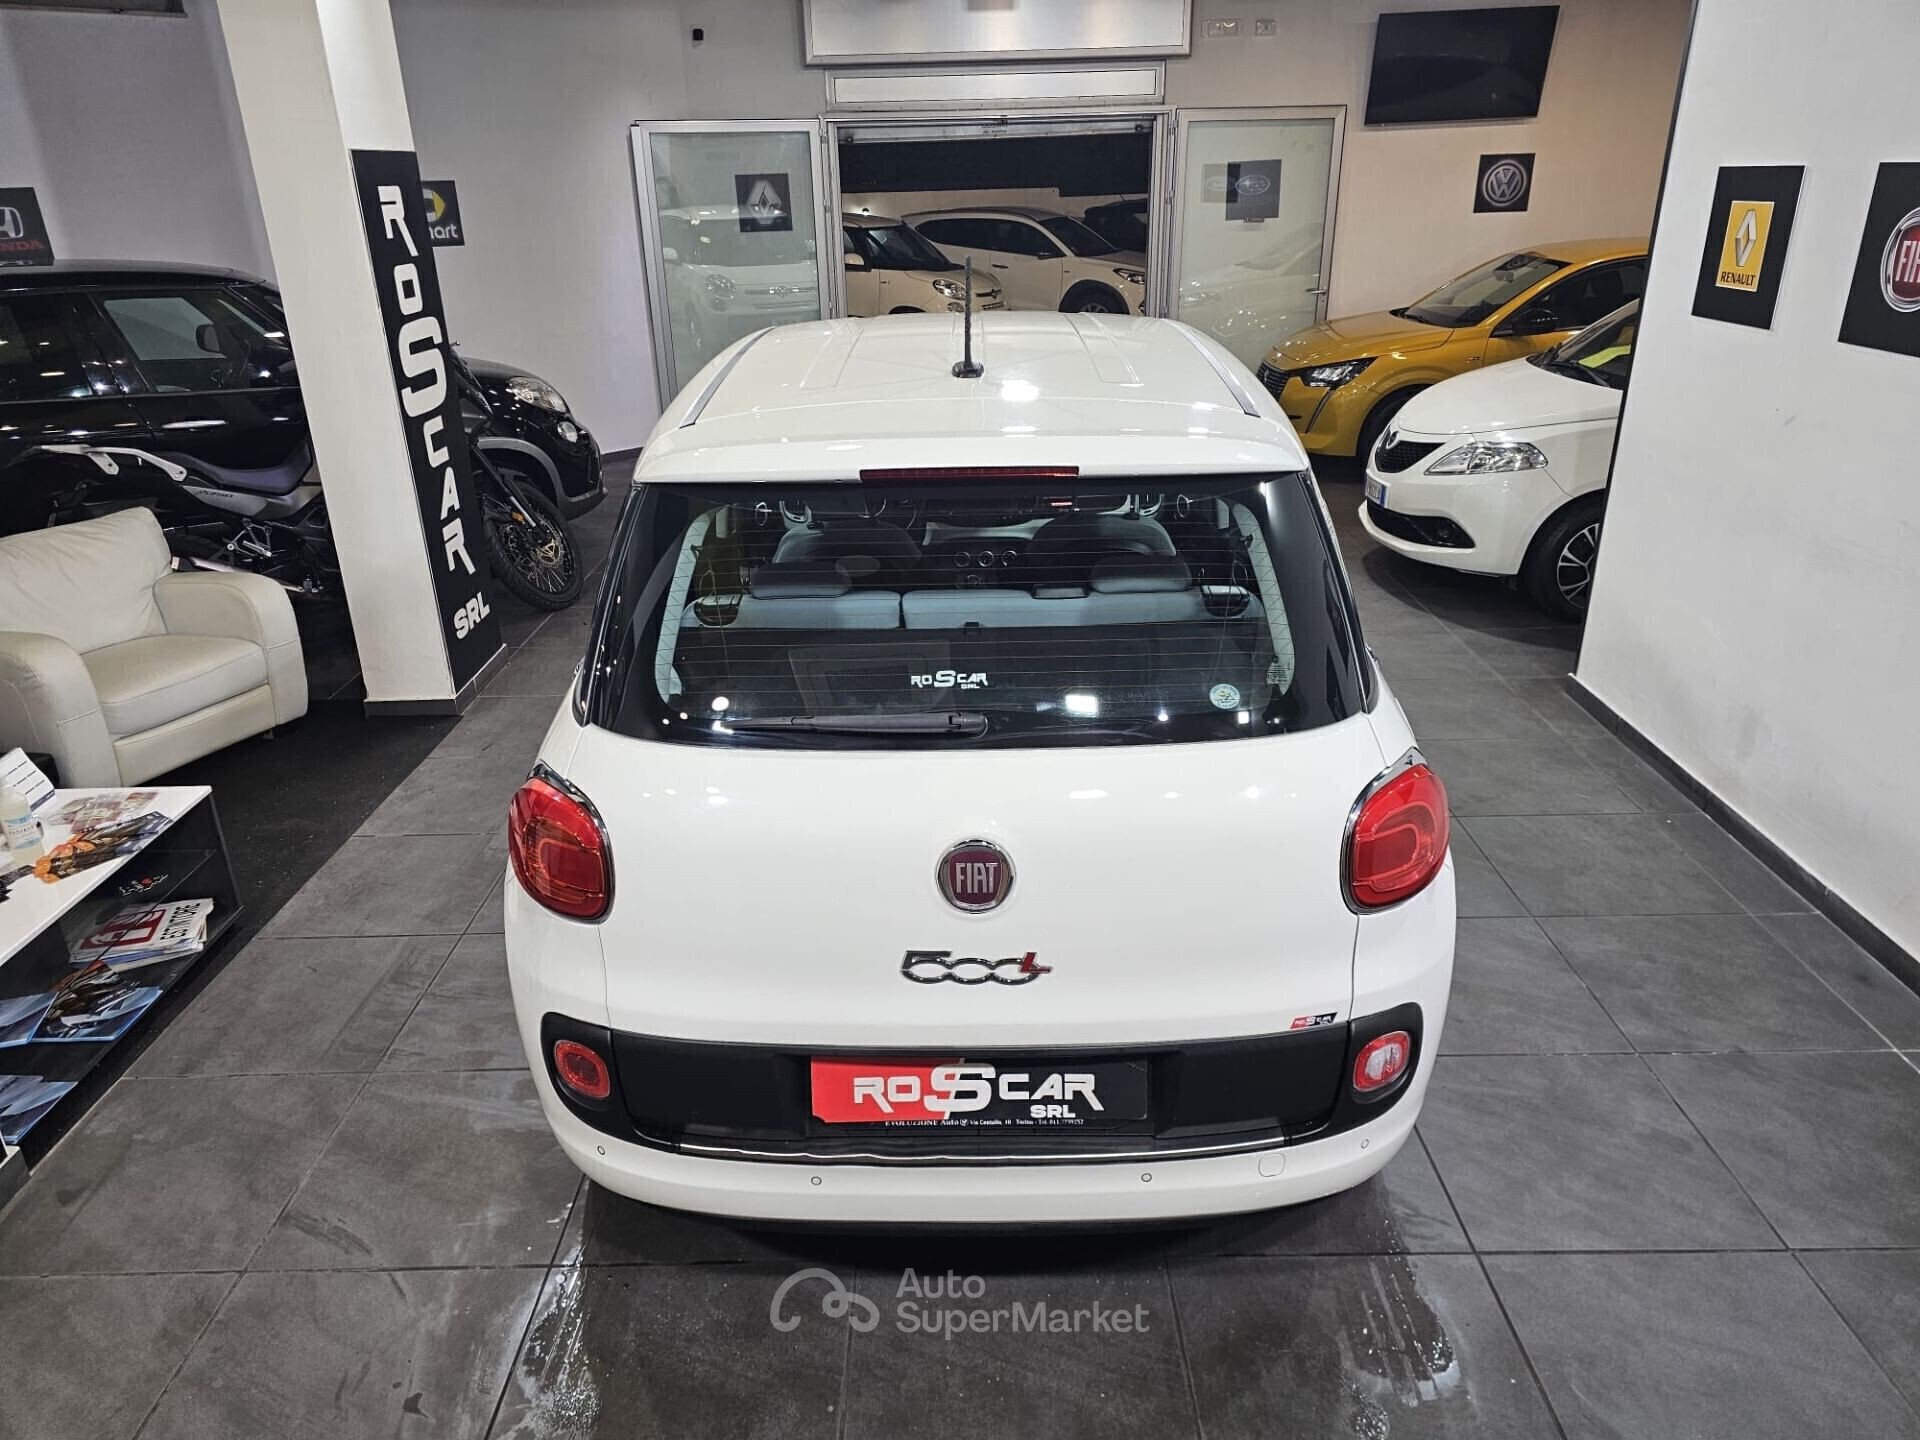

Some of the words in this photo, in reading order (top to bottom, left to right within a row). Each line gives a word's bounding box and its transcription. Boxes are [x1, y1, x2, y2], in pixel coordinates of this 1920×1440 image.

[1720, 271, 1756, 287] RENAULT
[454, 592, 490, 639] SRL
[955, 862, 998, 893] FIAT
[1030, 1104, 1076, 1119] SRL
